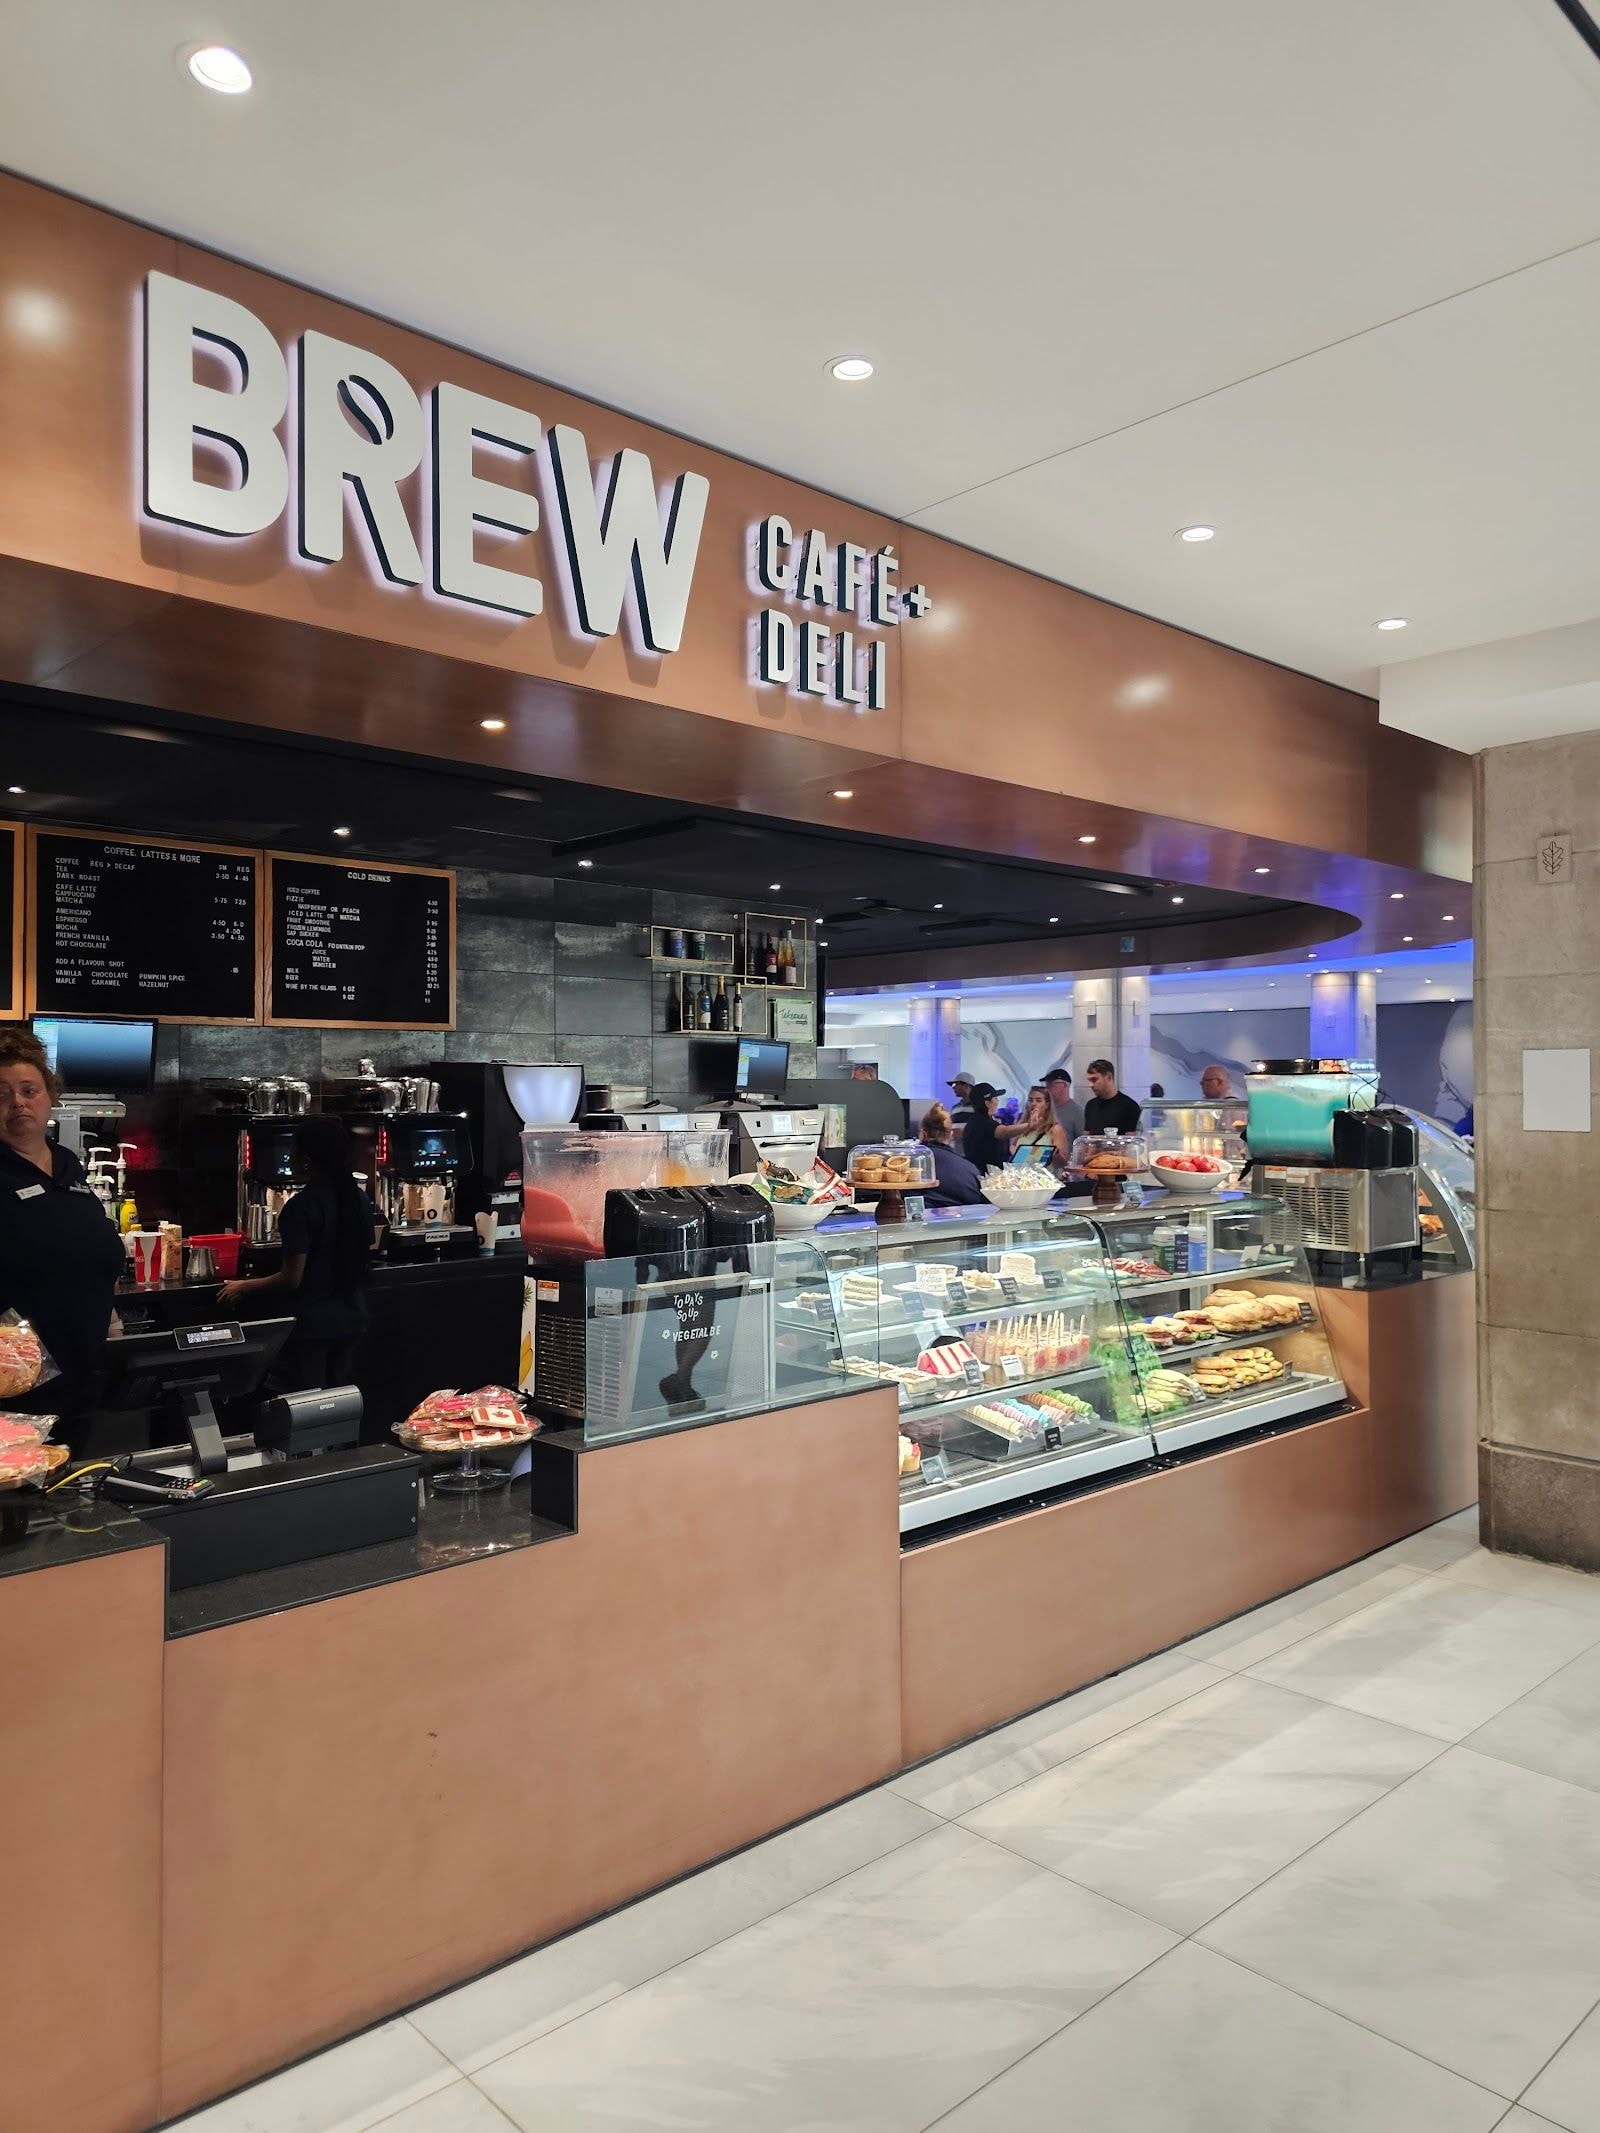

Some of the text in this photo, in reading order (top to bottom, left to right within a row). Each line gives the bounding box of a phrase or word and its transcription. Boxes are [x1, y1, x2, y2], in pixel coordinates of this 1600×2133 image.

[144, 269, 710, 655] BREW
[760, 608, 886, 710] DELI
[141, 850, 170, 860] LATTES
[180, 854, 200, 863] MORE
[347, 872, 391, 882] COLD DRINKS
[55, 890, 95, 898] CAPPUCCINO
[56, 908, 92, 916] AMERICANO
[305, 940, 323, 948] COLA
[674, 1292, 703, 1308] TODAYS
[677, 1308, 699, 1322] SOUP
[673, 1326, 720, 1342] VEGETALBE
